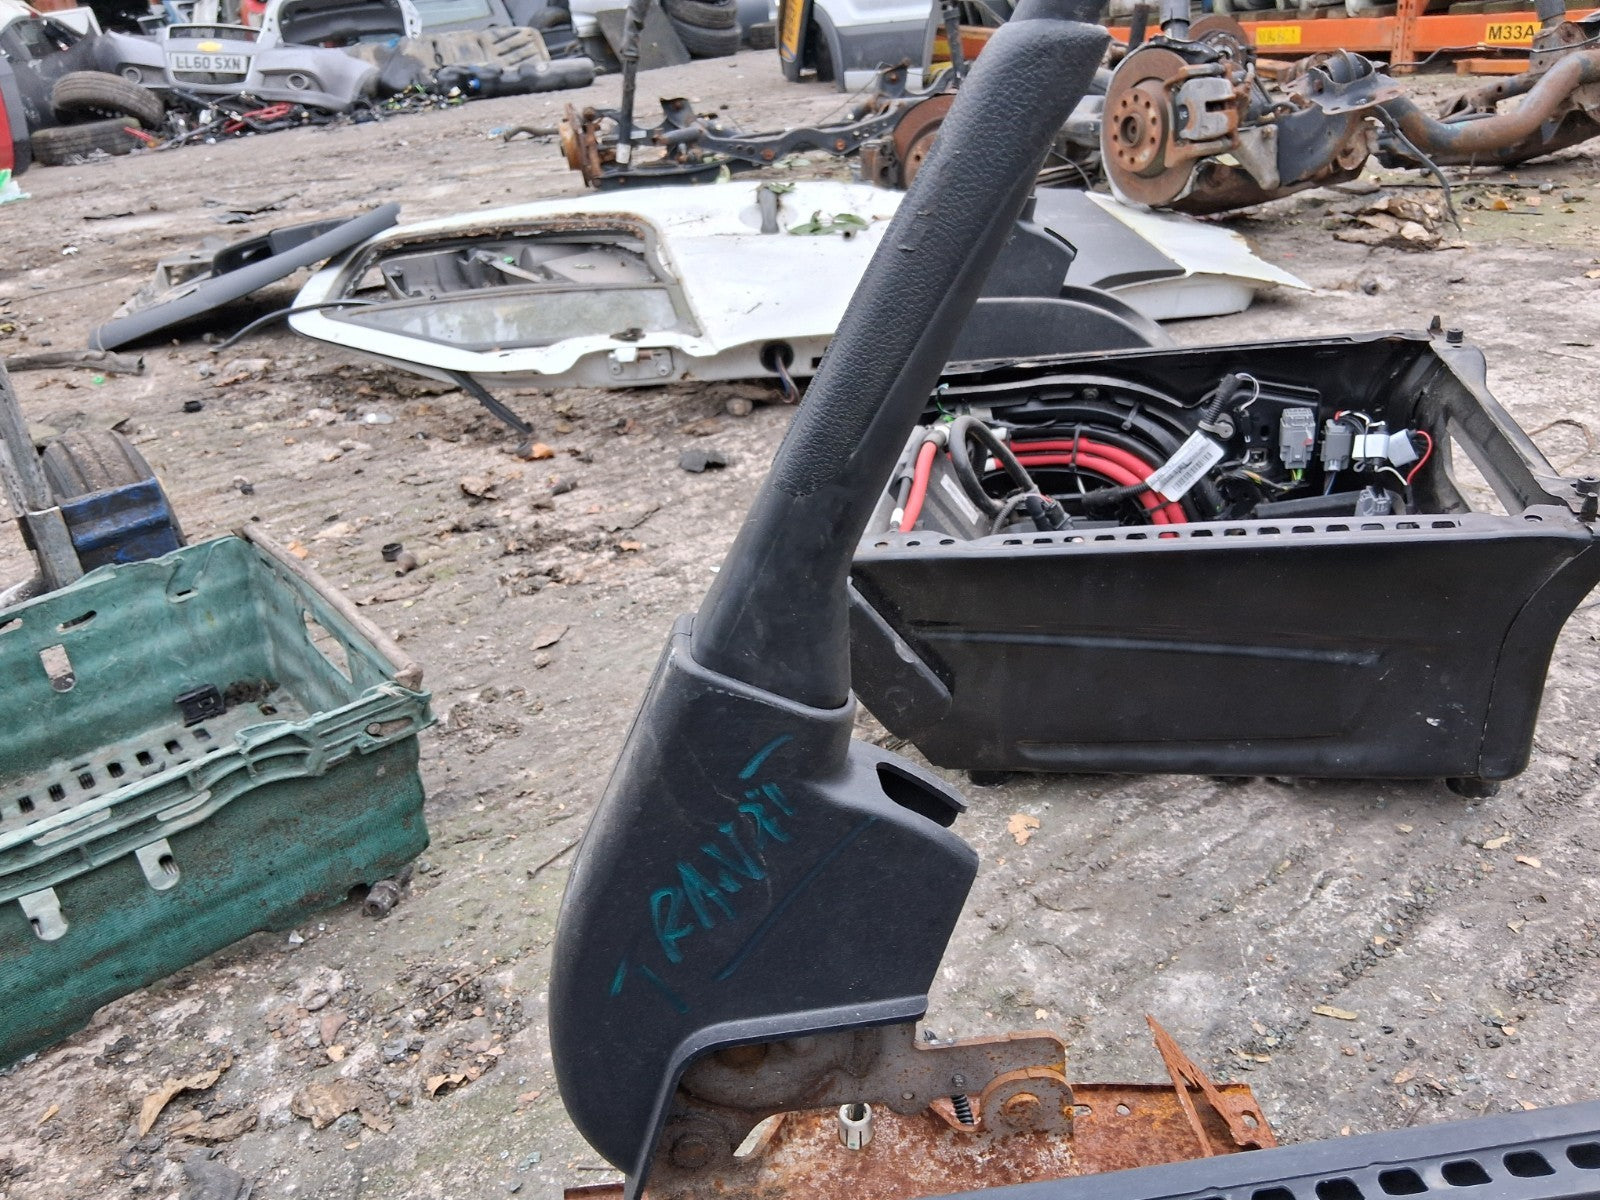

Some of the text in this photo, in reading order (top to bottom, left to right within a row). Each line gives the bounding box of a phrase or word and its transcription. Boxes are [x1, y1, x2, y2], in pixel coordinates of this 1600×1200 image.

[1488, 25, 1534, 40] M33A
[176, 56, 240, 70] LL60 SXN
